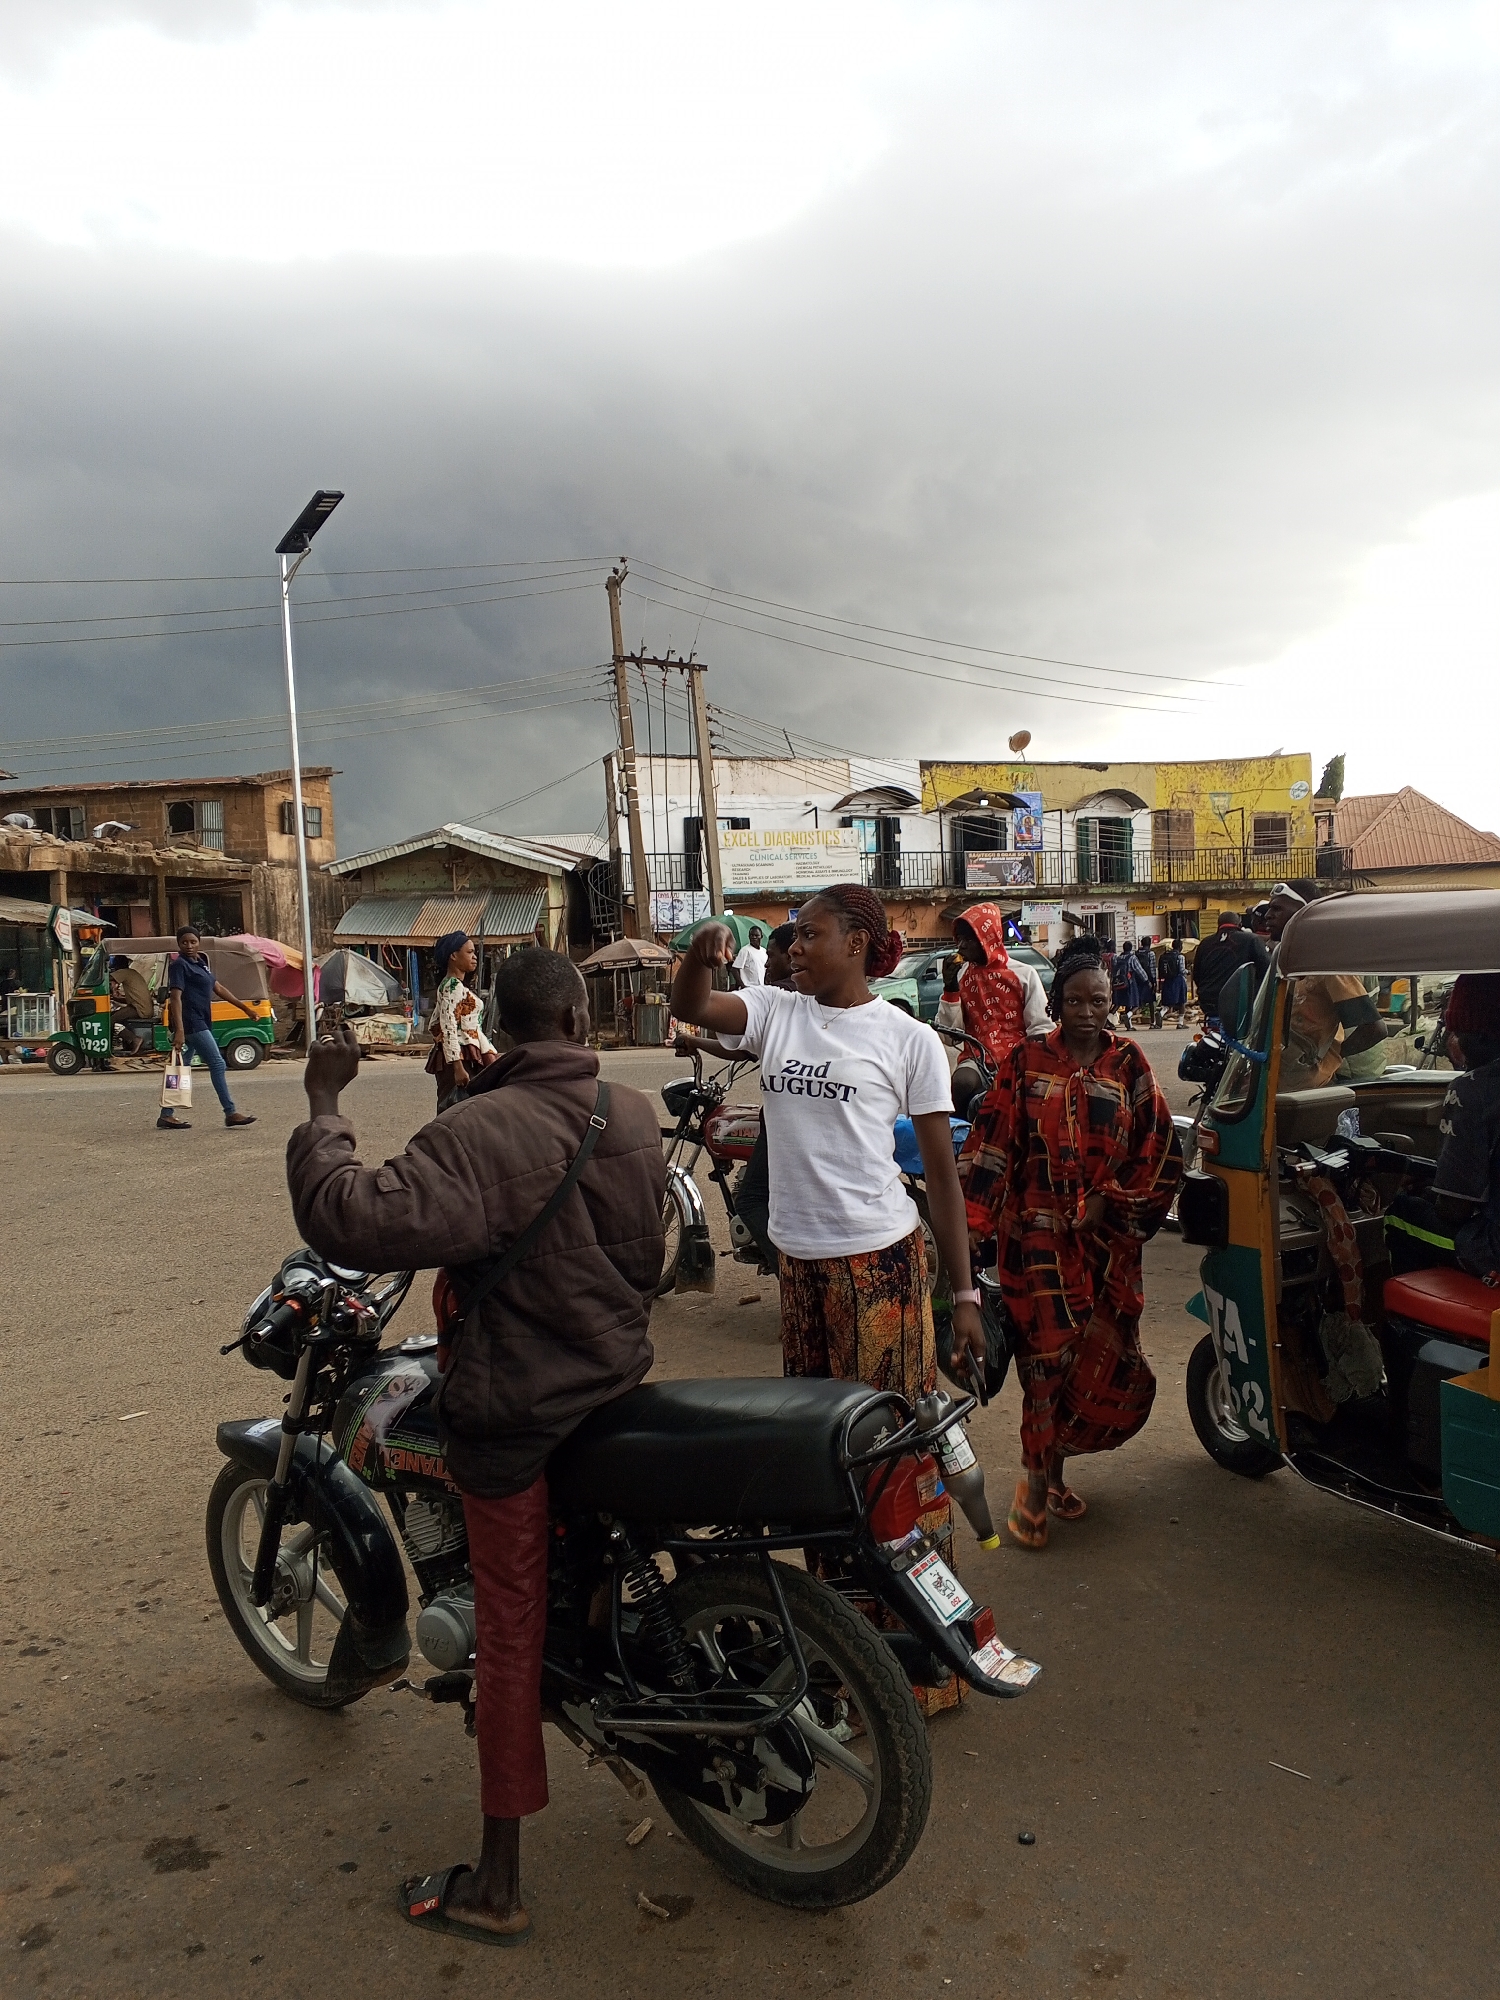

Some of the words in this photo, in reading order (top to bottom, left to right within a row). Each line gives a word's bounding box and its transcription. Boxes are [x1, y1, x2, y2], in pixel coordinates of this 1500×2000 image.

[724, 831, 760, 847] EXCEL
[764, 830, 841, 847] DIAGNOSTICS
[750, 853, 783, 861] CLINICAL
[785, 852, 818, 861] SERVICES
[982, 908, 996, 916] GAP
[981, 918, 993, 933] GAP
[988, 972, 1002, 980] GAP
[996, 982, 1011, 994] GAP
[986, 996, 1000, 1006] GAP
[1006, 1010, 1018, 1020] GAP
[82, 1021, 103, 1036] PT-
[80, 1037, 108, 1052] 8729
[781, 1059, 832, 1079] 2nd
[760, 1074, 858, 1102] AUGUST
[421, 1634, 450, 1652] TVS
